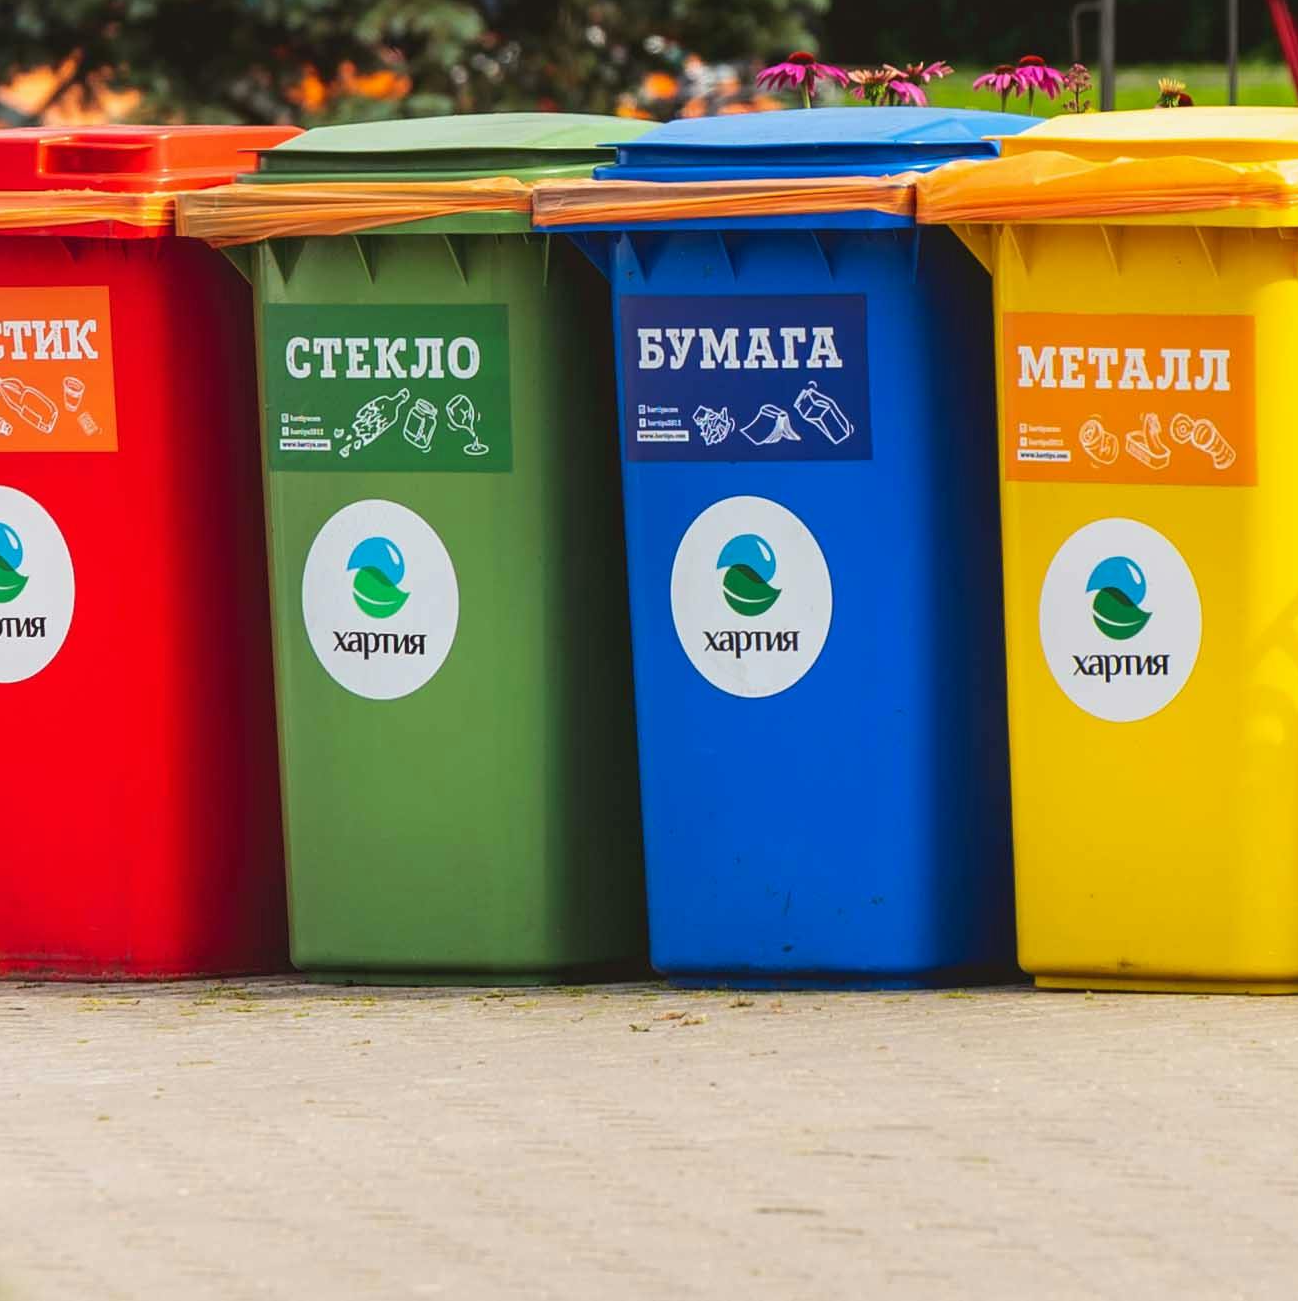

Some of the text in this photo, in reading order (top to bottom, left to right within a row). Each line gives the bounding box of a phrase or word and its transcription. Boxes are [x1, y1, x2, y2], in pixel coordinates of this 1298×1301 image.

[285, 336, 481, 380] СТЕКЛО
[636, 326, 843, 371] БУМАГА
[1017, 345, 1231, 392] МЕТАЛЛ
[333, 630, 428, 660] хартия
[702, 629, 800, 659] хартия
[1072, 653, 1170, 684] хартия
